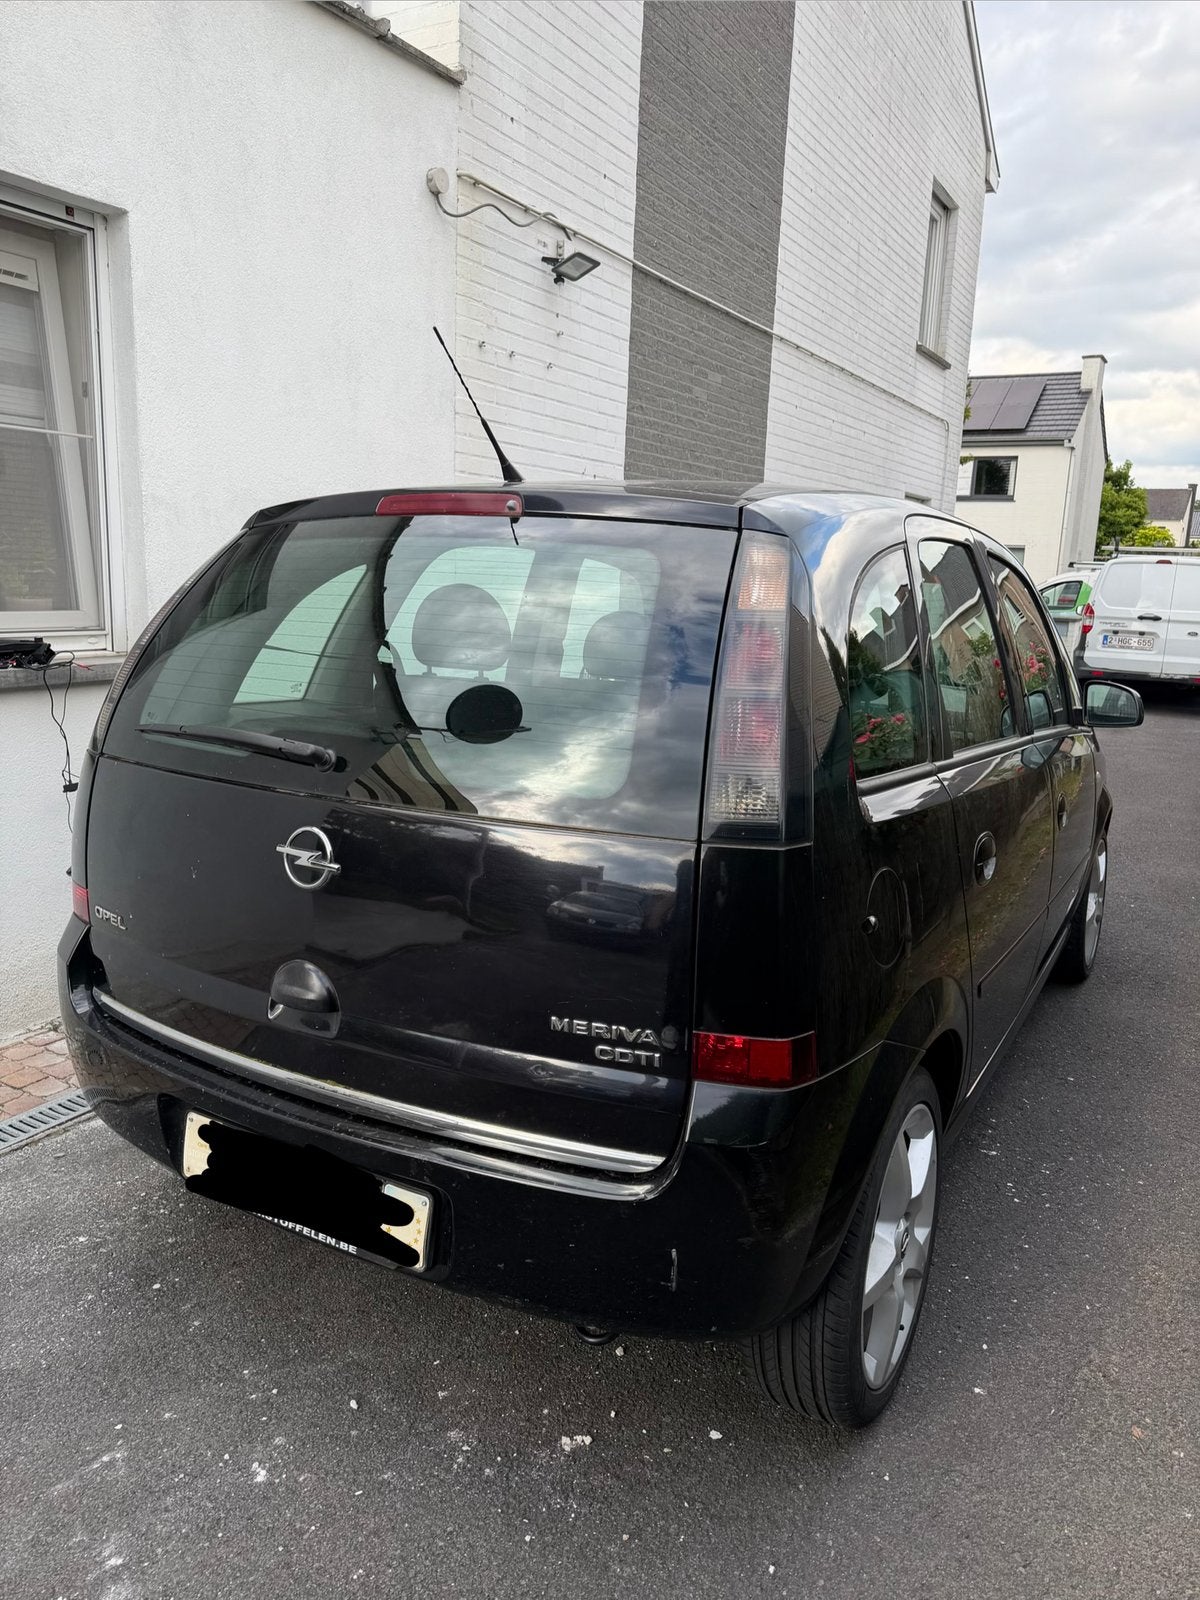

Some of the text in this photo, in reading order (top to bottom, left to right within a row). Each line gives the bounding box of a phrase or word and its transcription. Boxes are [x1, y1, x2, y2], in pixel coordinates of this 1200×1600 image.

[94, 905, 126, 930] OPEL
[550, 1015, 660, 1046] MERIVA
[594, 1044, 660, 1068] CDTI
